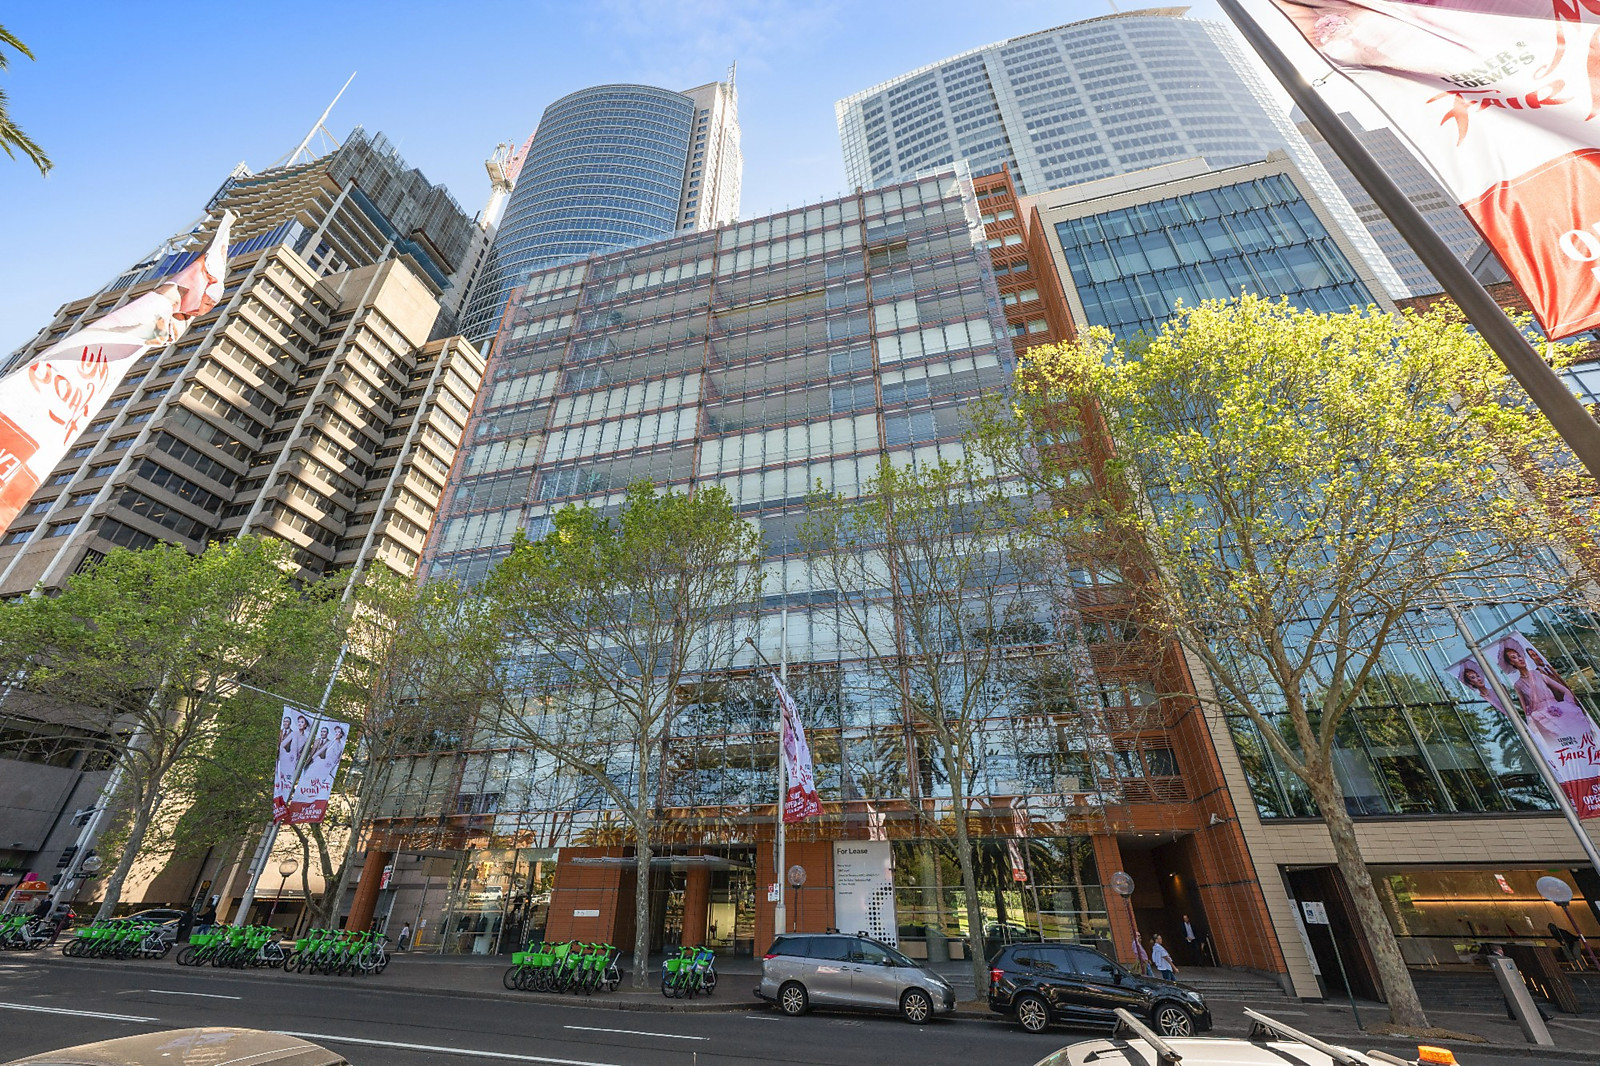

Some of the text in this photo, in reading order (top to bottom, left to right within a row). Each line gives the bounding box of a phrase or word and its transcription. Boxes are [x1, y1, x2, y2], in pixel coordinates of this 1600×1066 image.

[1454, 52, 1536, 89] LOEWE'S
[1425, 79, 1575, 147] FAIR
[1554, 747, 1587, 767] FAIR
[836, 847, 868, 855] For Lease
